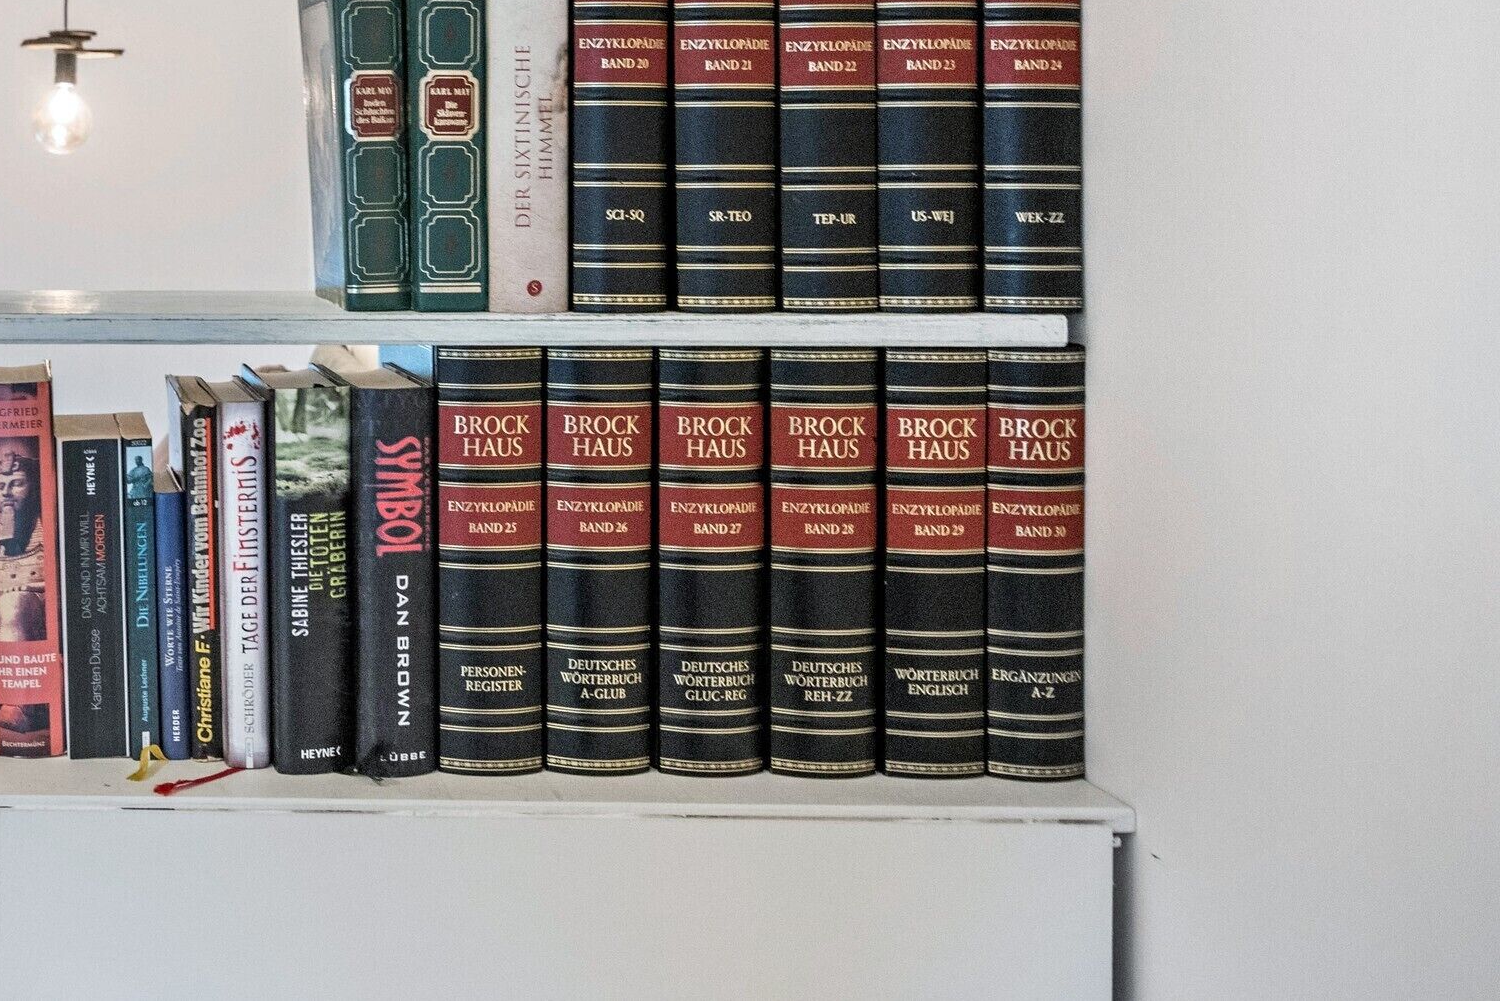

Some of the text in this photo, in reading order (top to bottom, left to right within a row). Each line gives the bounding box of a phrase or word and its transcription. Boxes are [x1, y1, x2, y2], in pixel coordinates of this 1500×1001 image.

[786, 40, 872, 53] ENZYKLOPÄDIE
[808, 61, 856, 72] BAND 22
[430, 88, 452, 96] KARL
[515, 44, 531, 228] DER SIXTINISCHE
[539, 92, 554, 181] HIMMEL
[813, 213, 856, 225] TEP-UR
[87, 462, 96, 495] HEYNE
[373, 435, 424, 557] SYMBOL
[79, 512, 92, 619] DAS KIND IN MIR WILL
[94, 514, 107, 614] ACHTSAM MORDEN
[309, 512, 329, 591] DIE TOTEN
[326, 510, 346, 600] GRÄBERIN
[135, 522, 149, 628] DIE NIBELUNGEN
[190, 417, 213, 743] Christiane F. Wir Kinder vom Bahnhof Zoo
[290, 513, 309, 638] SABINE THIESLER
[241, 576, 258, 606] DER
[163, 566, 175, 667] WORTE WIE STERNE
[241, 612, 258, 654] TAGE
[23, 653, 57, 664] BAUTE
[396, 575, 410, 727] DAN BROWN
[568, 658, 637, 671] DEUTSCHES
[1, 680, 41, 688] TEMPEL
[15, 667, 47, 676] EINEN
[89, 629, 103, 710] Karsten Dusse
[460, 665, 526, 678] PERSONEN-
[561, 669, 641, 686] WÖRTERBUCH
[895, 665, 978, 682] WÖRTERBUCH
[992, 667, 1082, 683] ERGÄNZUNGEN
[242, 663, 255, 734] SCHRÖDER
[466, 679, 523, 692] REGISTER
[581, 686, 626, 700] A-GLUB
[908, 682, 969, 695] ENGLISCH
[1031, 685, 1055, 698] A-Z
[142, 690, 150, 722] Auguste
[301, 747, 335, 760] HEYNE
